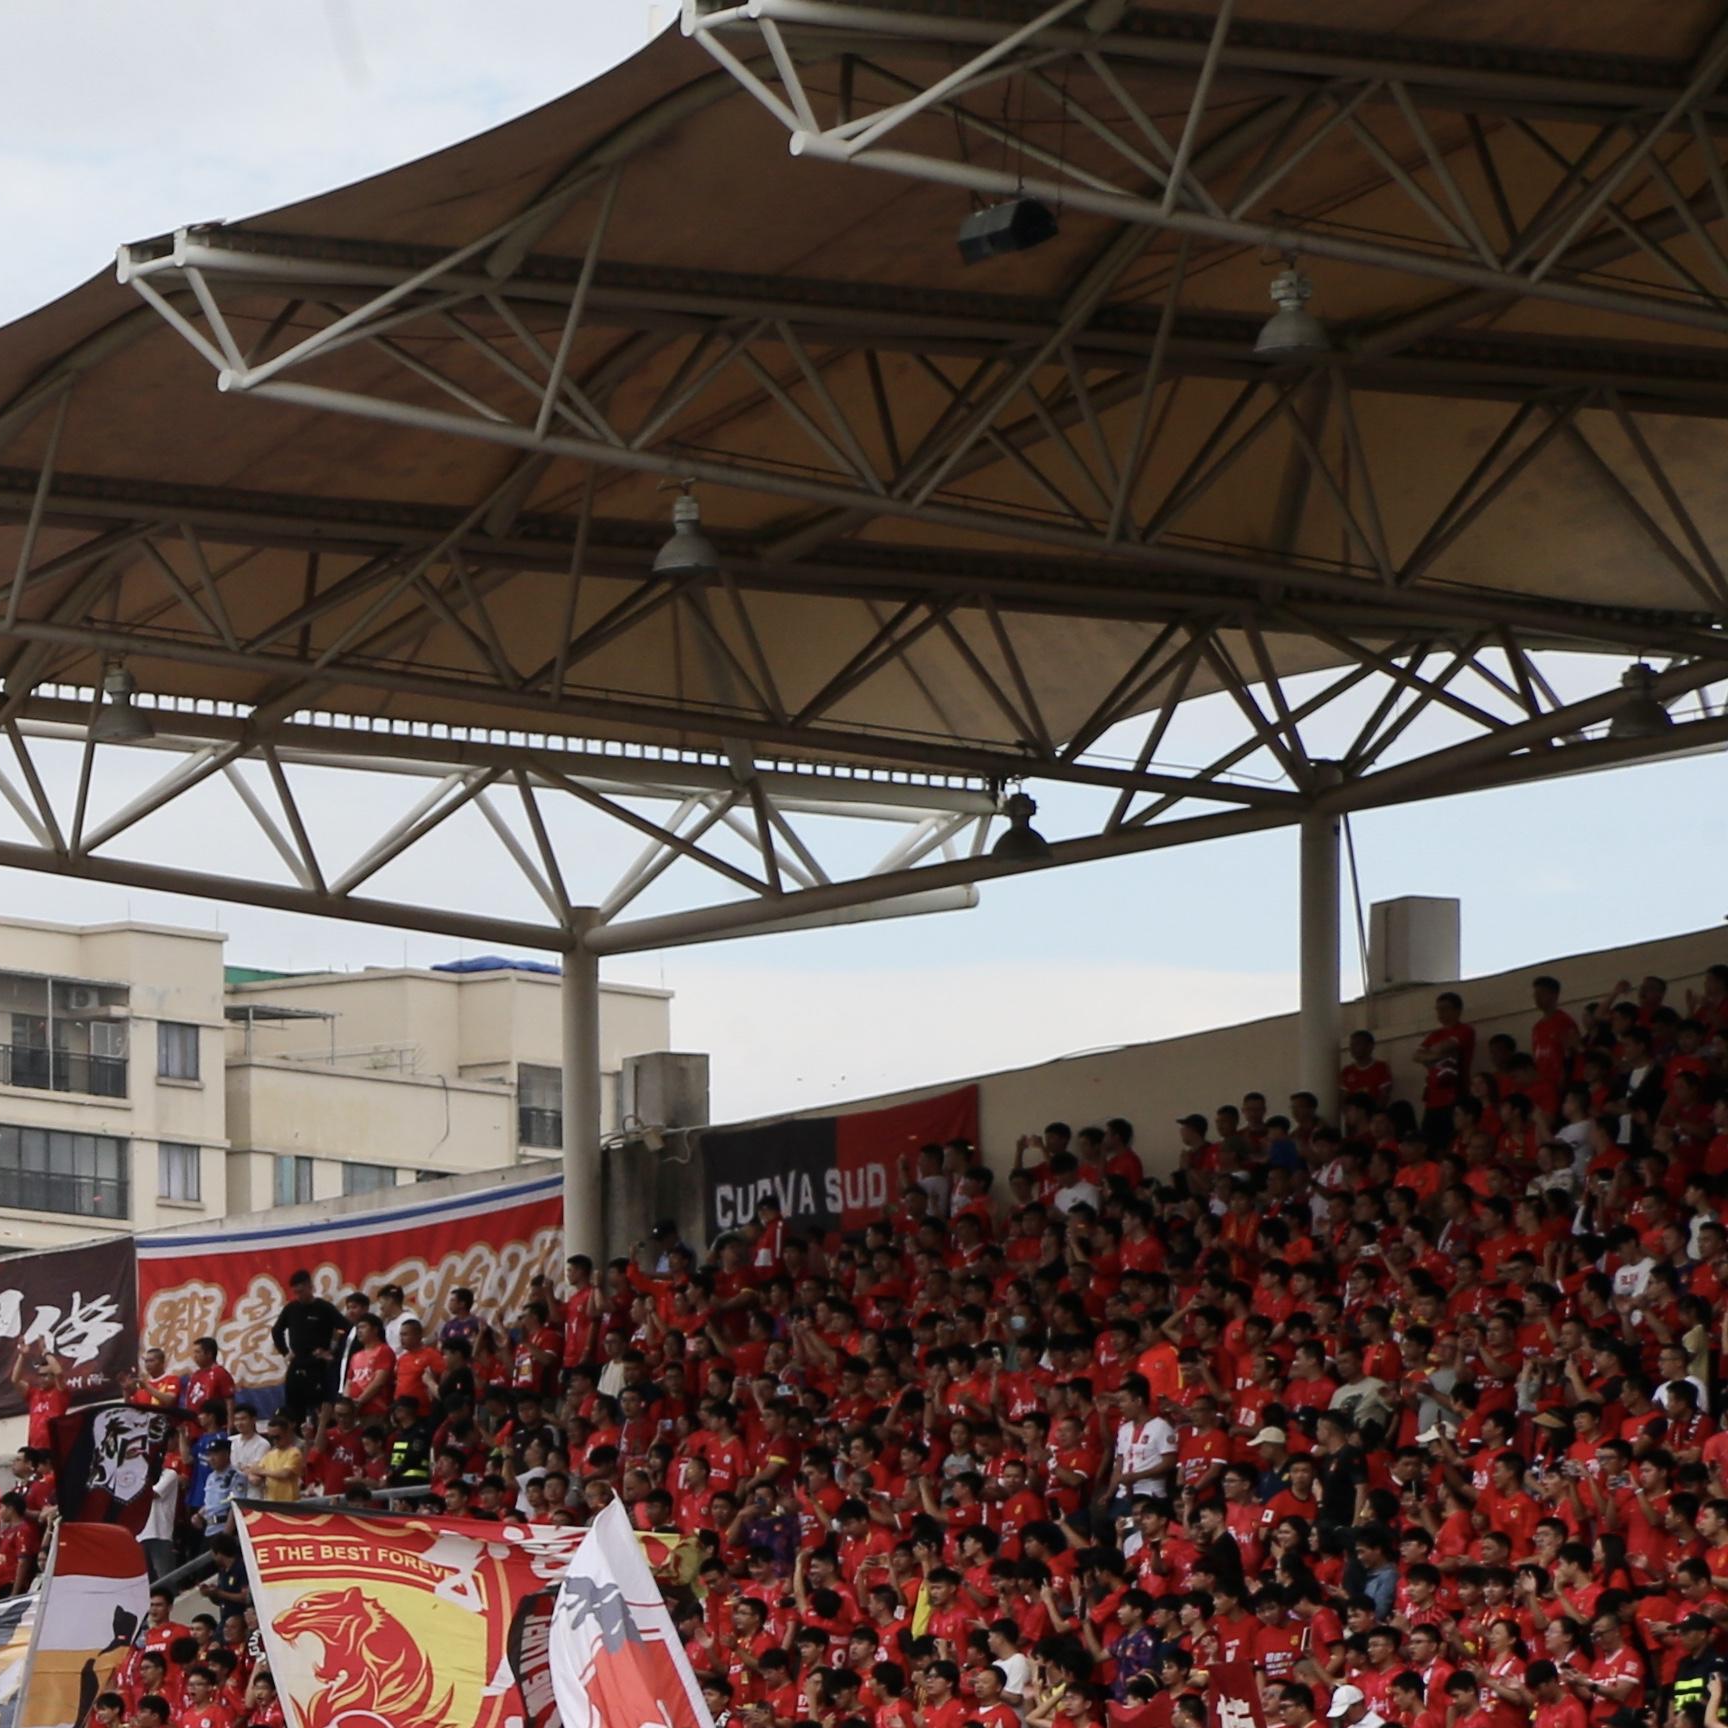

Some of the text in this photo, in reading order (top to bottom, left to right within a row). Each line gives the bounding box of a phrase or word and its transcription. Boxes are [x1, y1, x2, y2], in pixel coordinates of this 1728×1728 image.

[824, 1162, 887, 1214] SUD
[275, 1546, 314, 1563] THE
[320, 1545, 372, 1564] BEST
